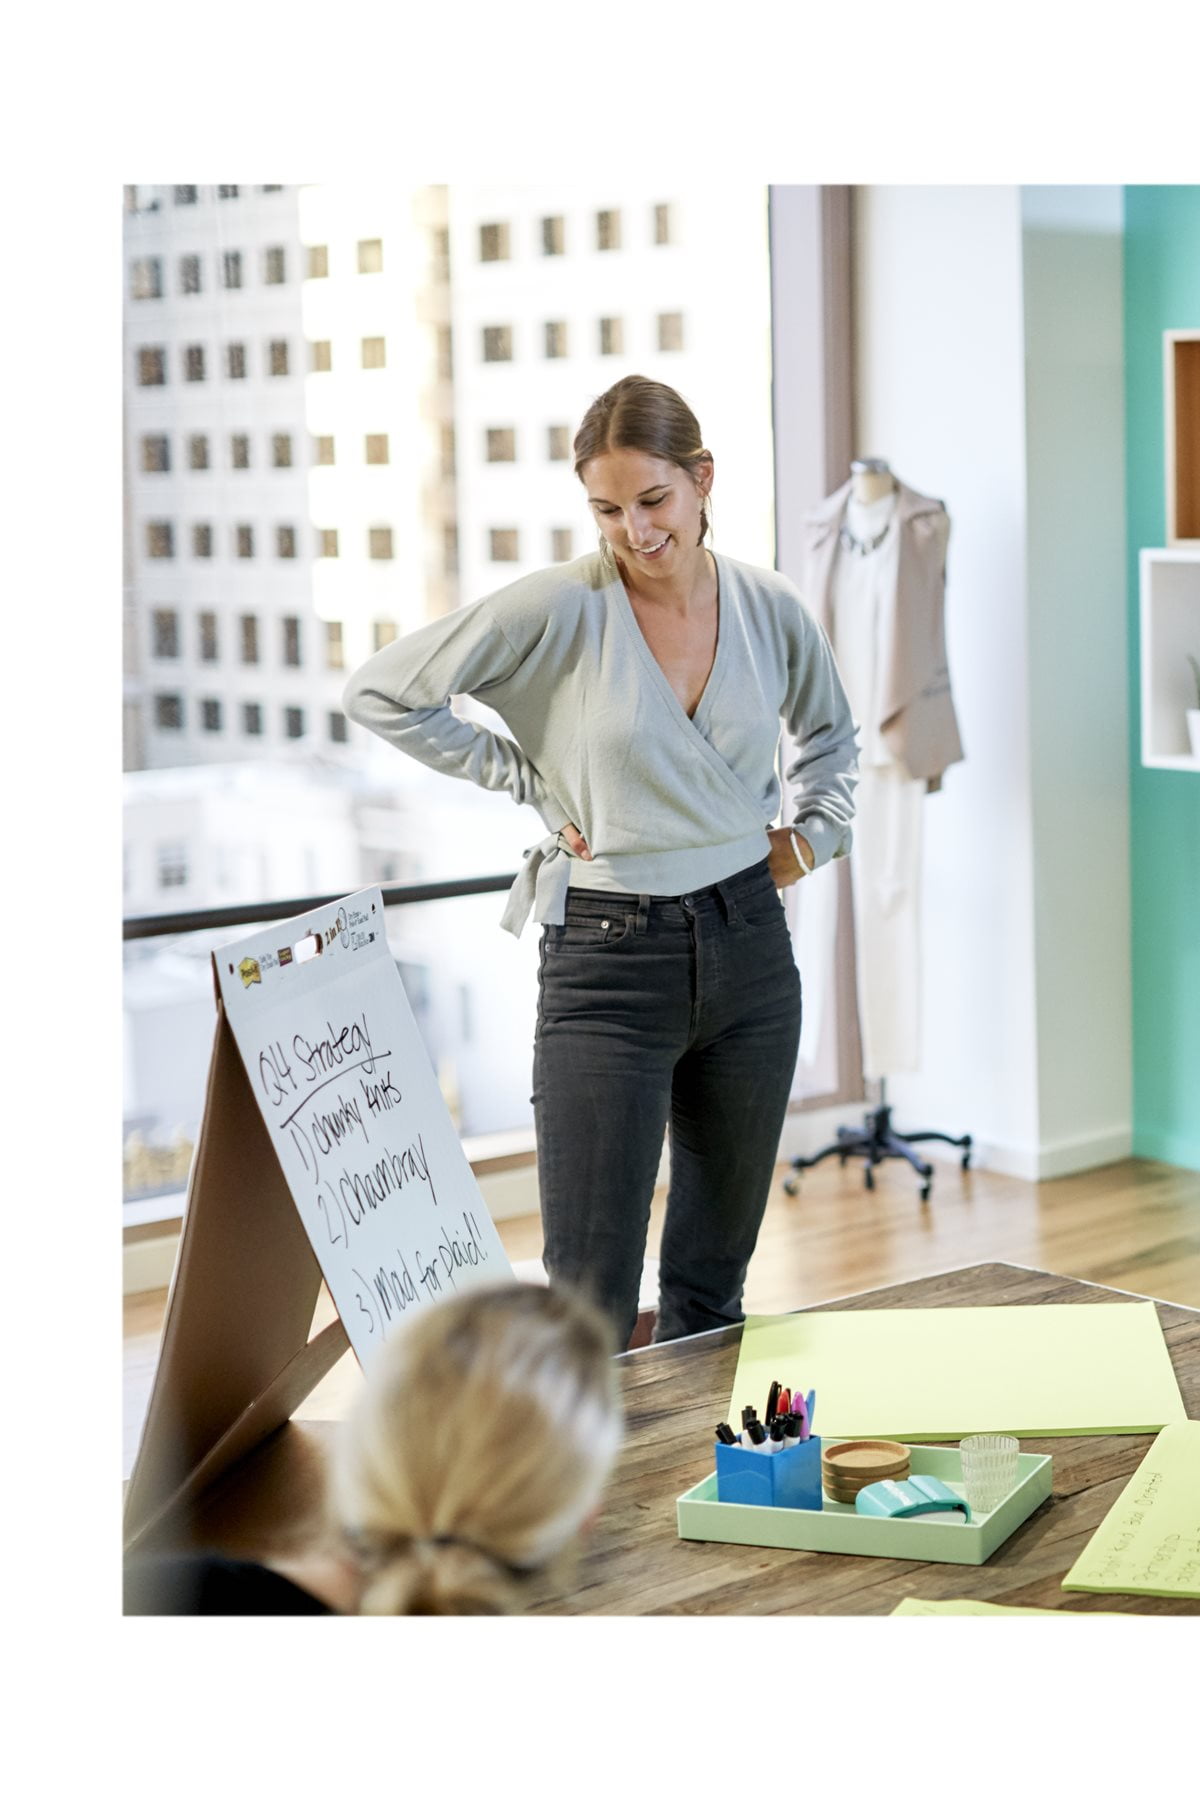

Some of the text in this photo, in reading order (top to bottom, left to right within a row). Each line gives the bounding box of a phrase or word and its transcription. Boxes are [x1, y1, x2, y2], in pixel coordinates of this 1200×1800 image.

[259, 1012, 376, 1106] Q4 Strategy
[415, 1250, 442, 1304] for
